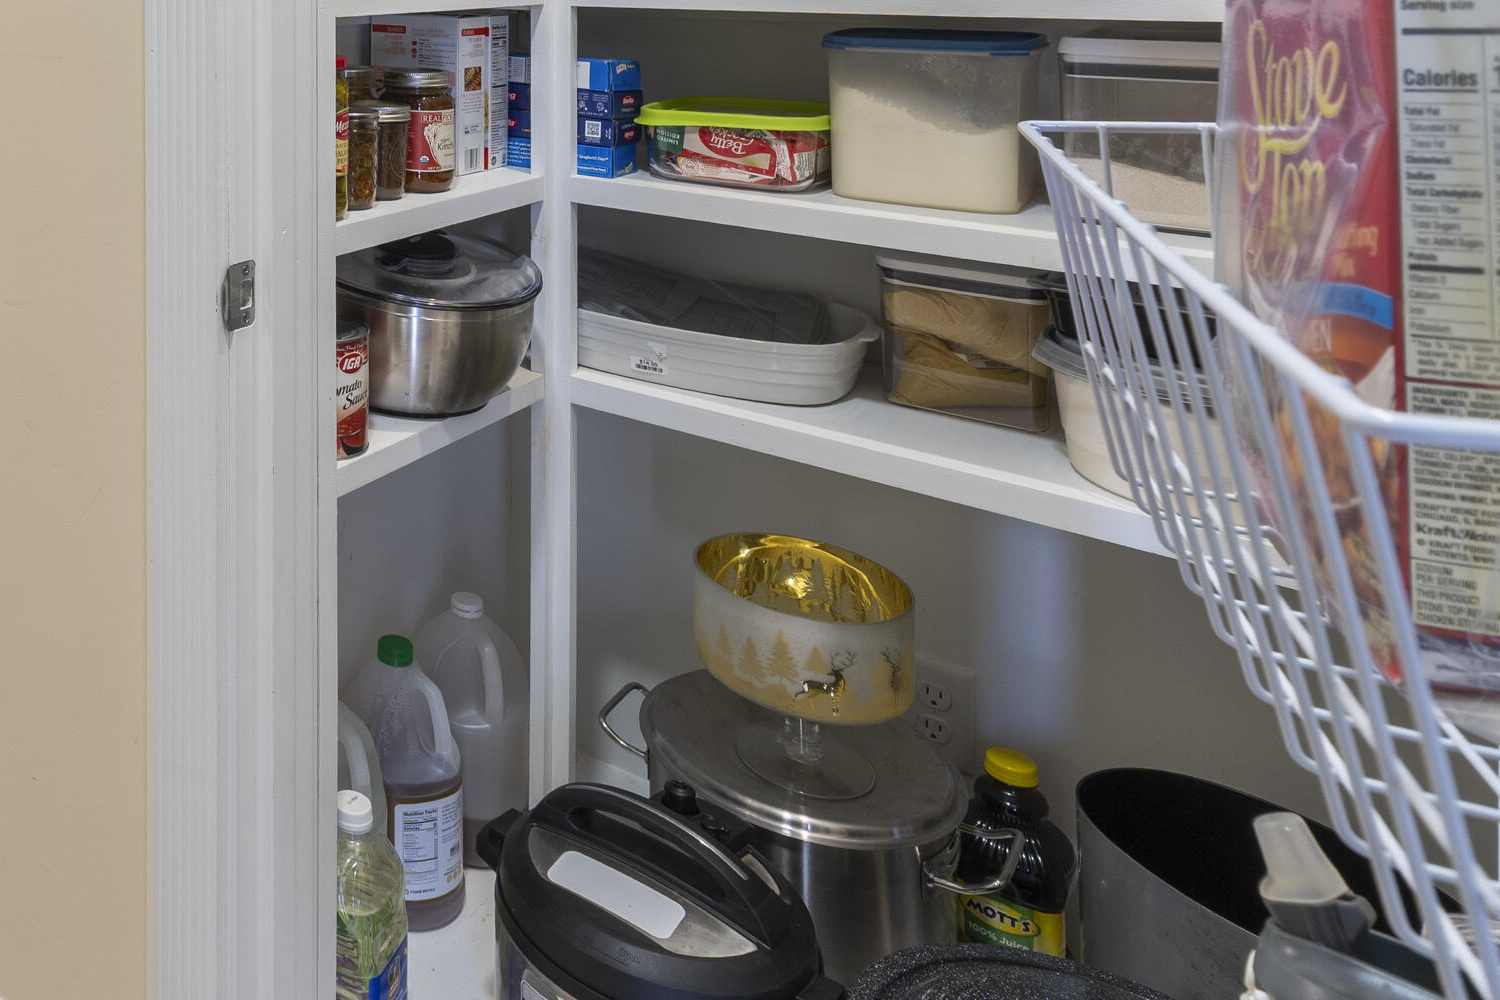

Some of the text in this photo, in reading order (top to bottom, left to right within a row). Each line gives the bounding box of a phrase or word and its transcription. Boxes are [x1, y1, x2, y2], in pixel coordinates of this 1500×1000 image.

[1400, 0, 1475, 13] Serving size
[1403, 68, 1479, 87] Calories
[1243, 18, 1348, 192] Stove
[1404, 106, 1441, 117] Total Fat
[656, 134, 680, 146] LIMITED
[709, 134, 746, 155] Betty
[1405, 171, 1436, 181] Sodium
[1406, 186, 1426, 197] Total
[342, 356, 361, 371] IGA
[968, 920, 998, 941] 100%
